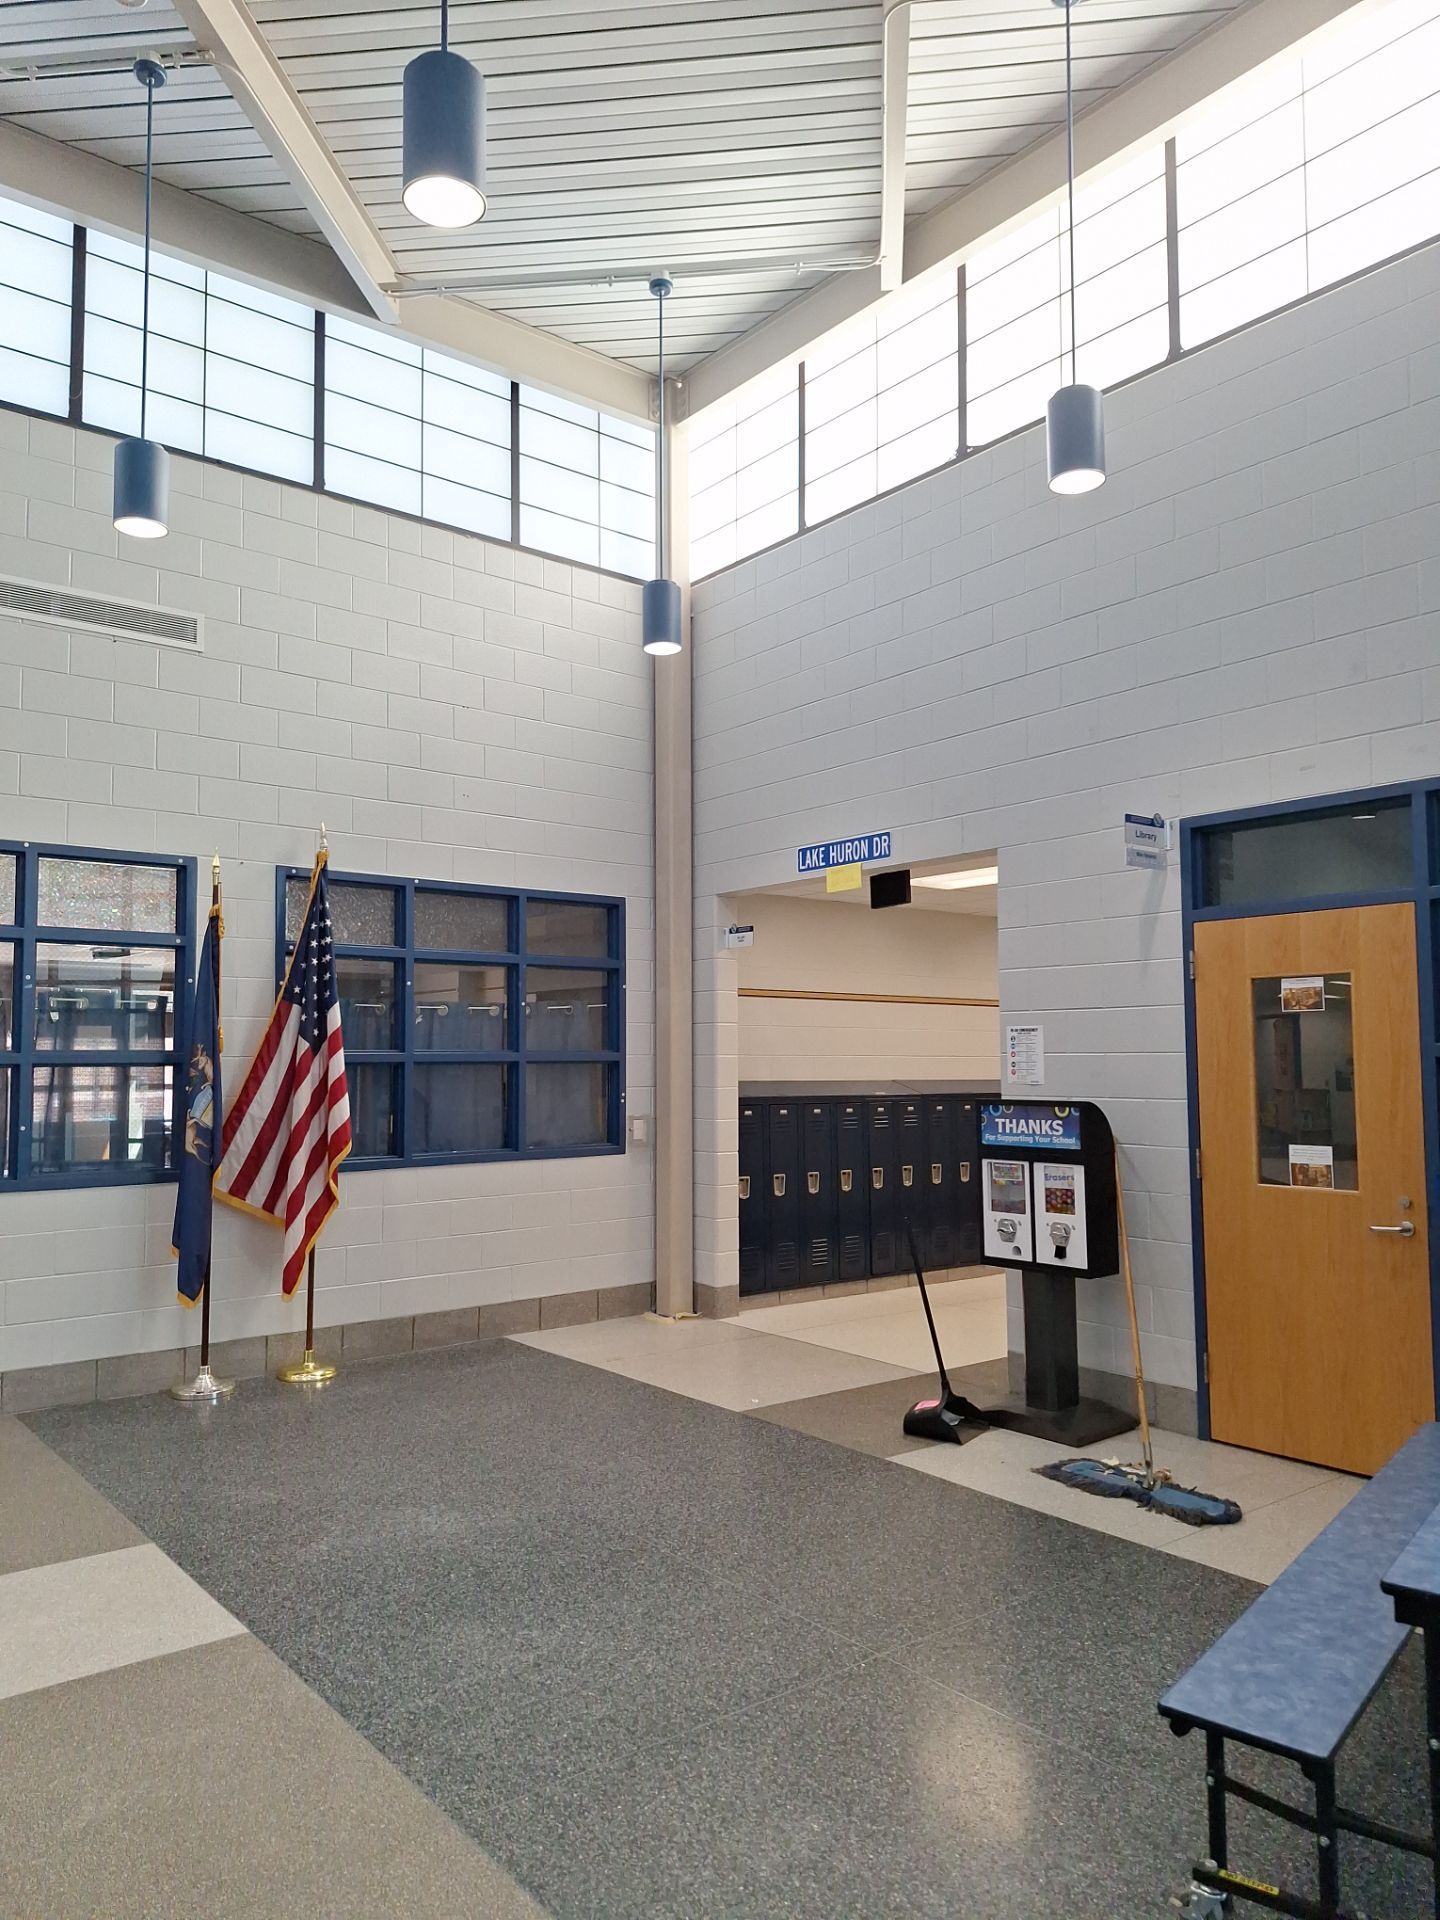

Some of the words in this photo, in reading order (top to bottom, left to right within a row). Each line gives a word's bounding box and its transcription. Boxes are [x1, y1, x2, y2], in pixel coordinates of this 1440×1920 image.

[1135, 830, 1157, 842] Library
[799, 848, 826, 869] LAKE
[829, 839, 868, 864] HURON
[873, 835, 889, 857] DR
[995, 1119, 1063, 1135] THANKS
[985, 1133, 996, 1141] For
[997, 1134, 1033, 1143] Supporting
[1035, 1135, 1051, 1143] Your
[1052, 1136, 1076, 1144] School
